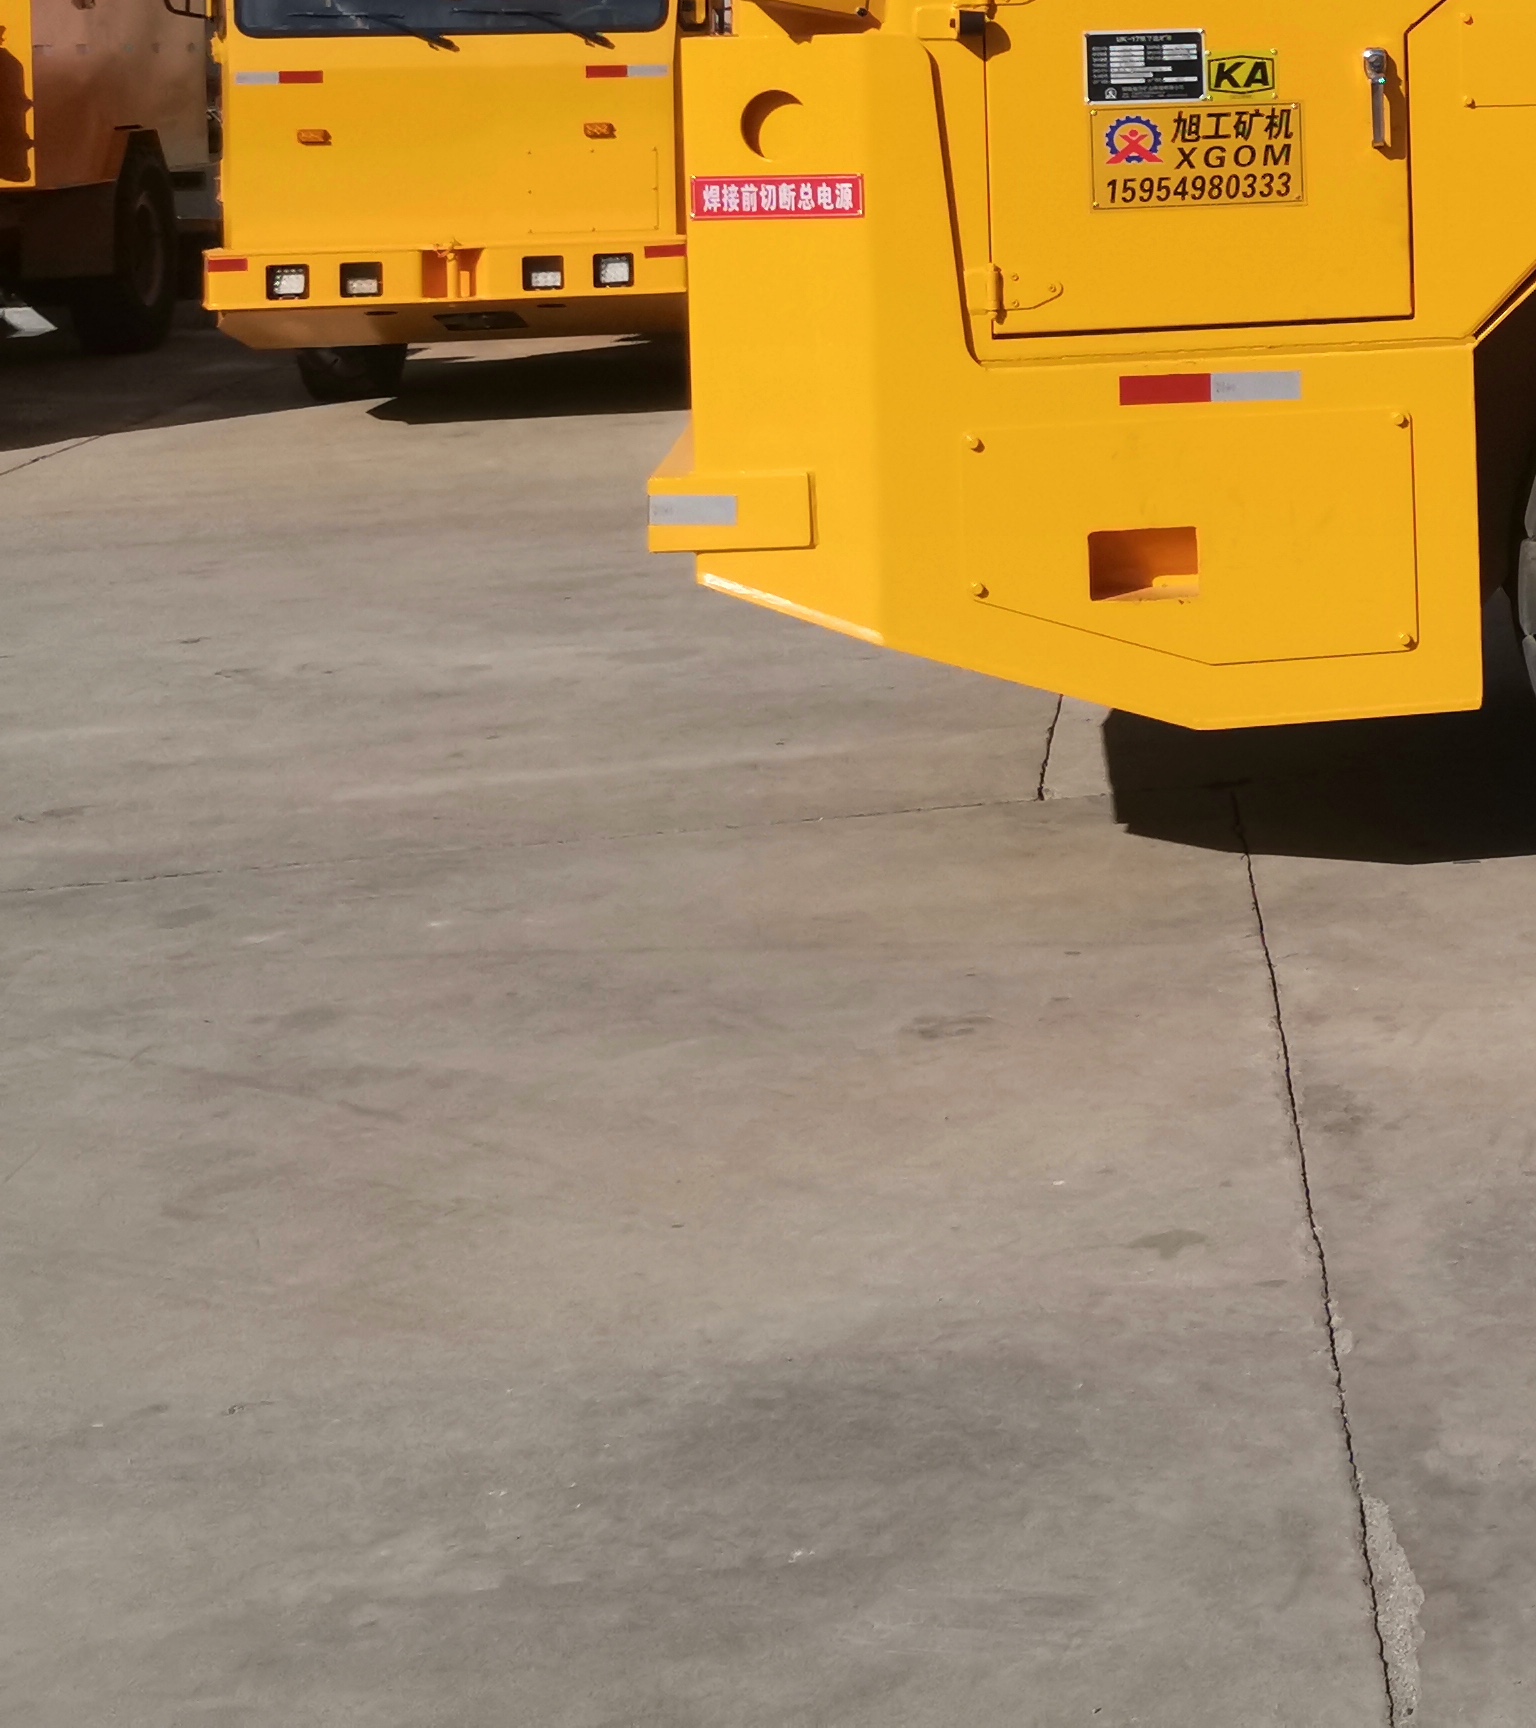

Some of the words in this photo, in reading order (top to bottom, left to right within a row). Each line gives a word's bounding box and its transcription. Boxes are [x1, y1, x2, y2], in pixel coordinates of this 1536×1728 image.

[1213, 61, 1270, 89] KA
[1170, 107, 1294, 143] 旭工矿机
[1173, 143, 1292, 170] XGOM
[702, 182, 854, 213] 焊接前切断总电源
[1106, 172, 1292, 204] 15954980333
